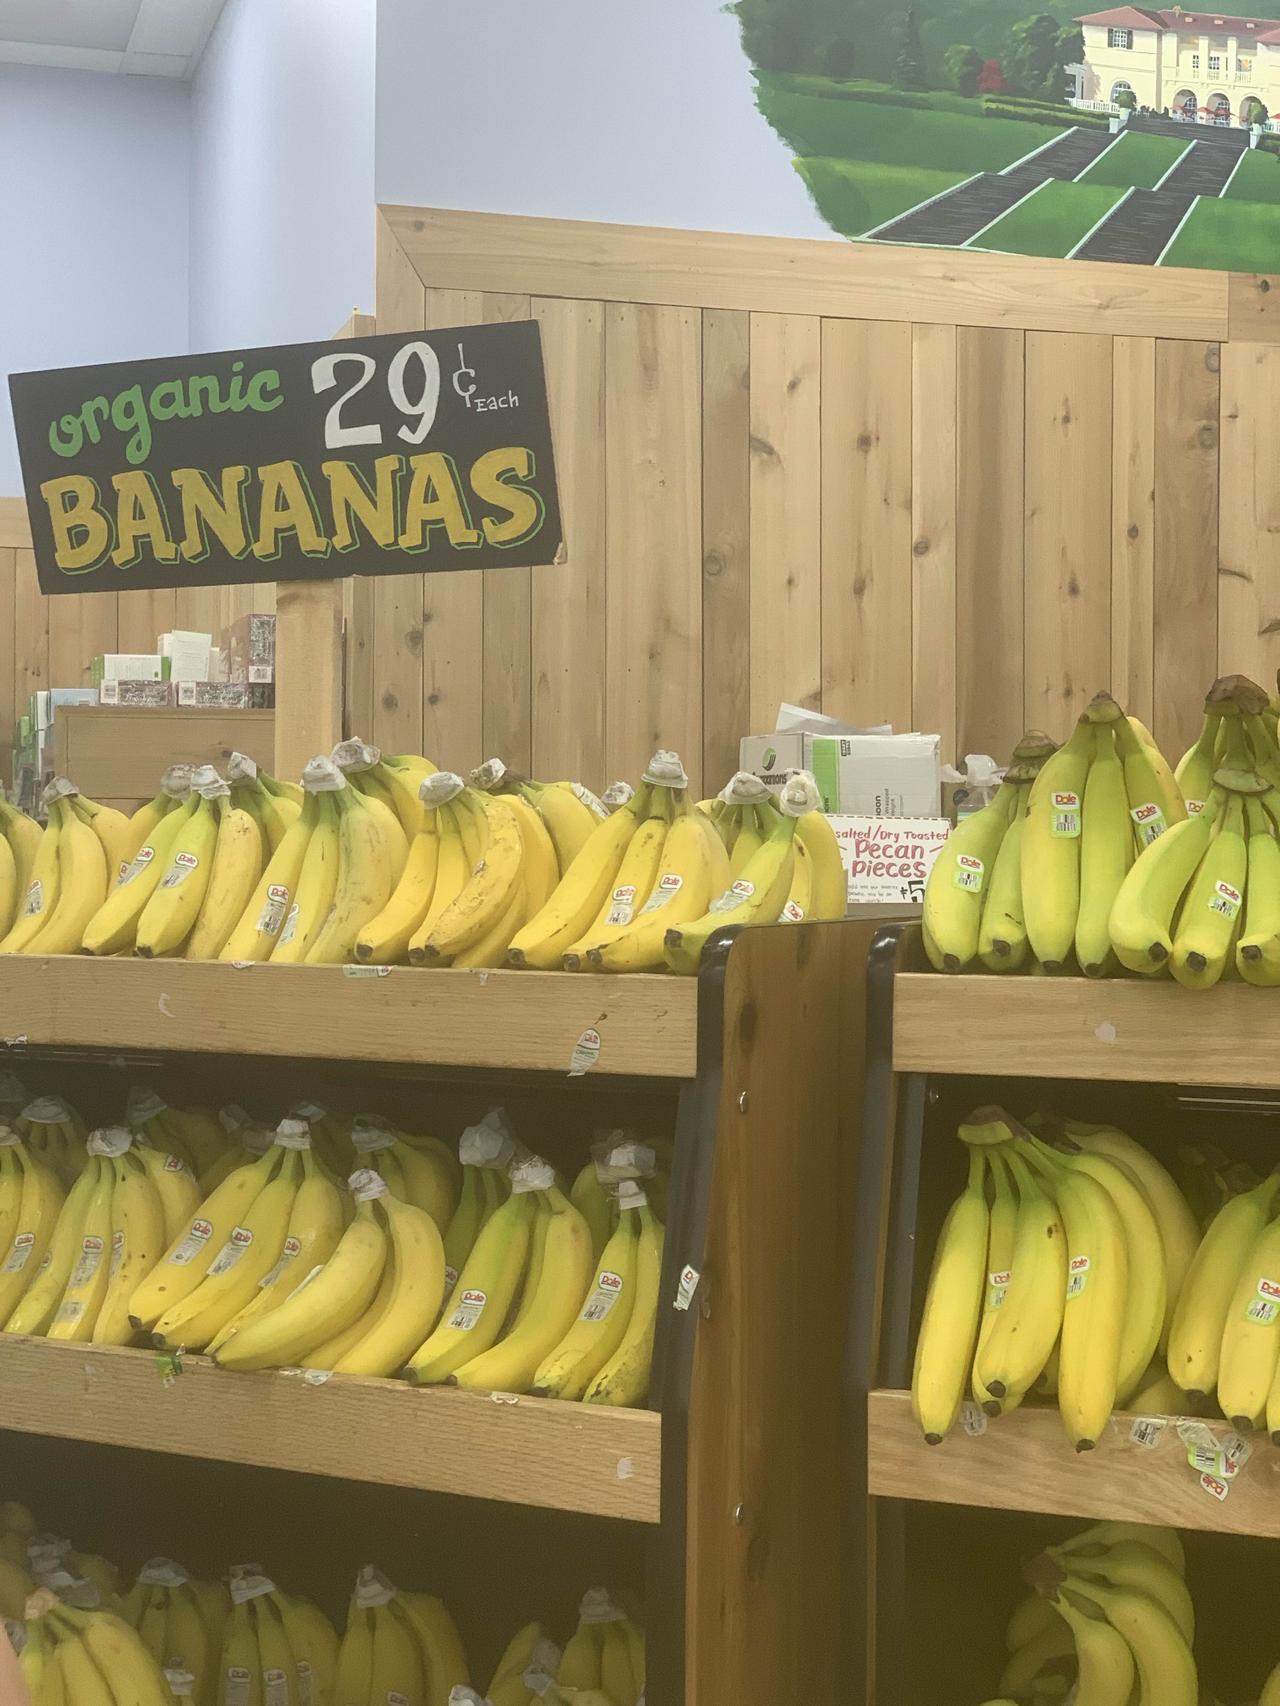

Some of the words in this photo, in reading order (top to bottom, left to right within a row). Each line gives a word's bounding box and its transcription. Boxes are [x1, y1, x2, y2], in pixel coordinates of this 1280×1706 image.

[474, 390, 519, 412] Each
[49, 361, 285, 464] organic
[40, 446, 546, 575] BANANAS
[1056, 793, 1076, 804] Dole
[1136, 806, 1156, 819] Dole
[855, 839, 925, 859] Pecan
[960, 856, 981, 870] Dole
[662, 877, 680, 885] Dole
[1220, 884, 1240, 900] Dole
[193, 1222, 211, 1234] Dole
[234, 1230, 251, 1242] Dole
[1072, 1258, 1088, 1269] Dole
[601, 1275, 620, 1287] Dole
[464, 1291, 484, 1300] Dole
[1202, 1474, 1223, 1494] Dole
